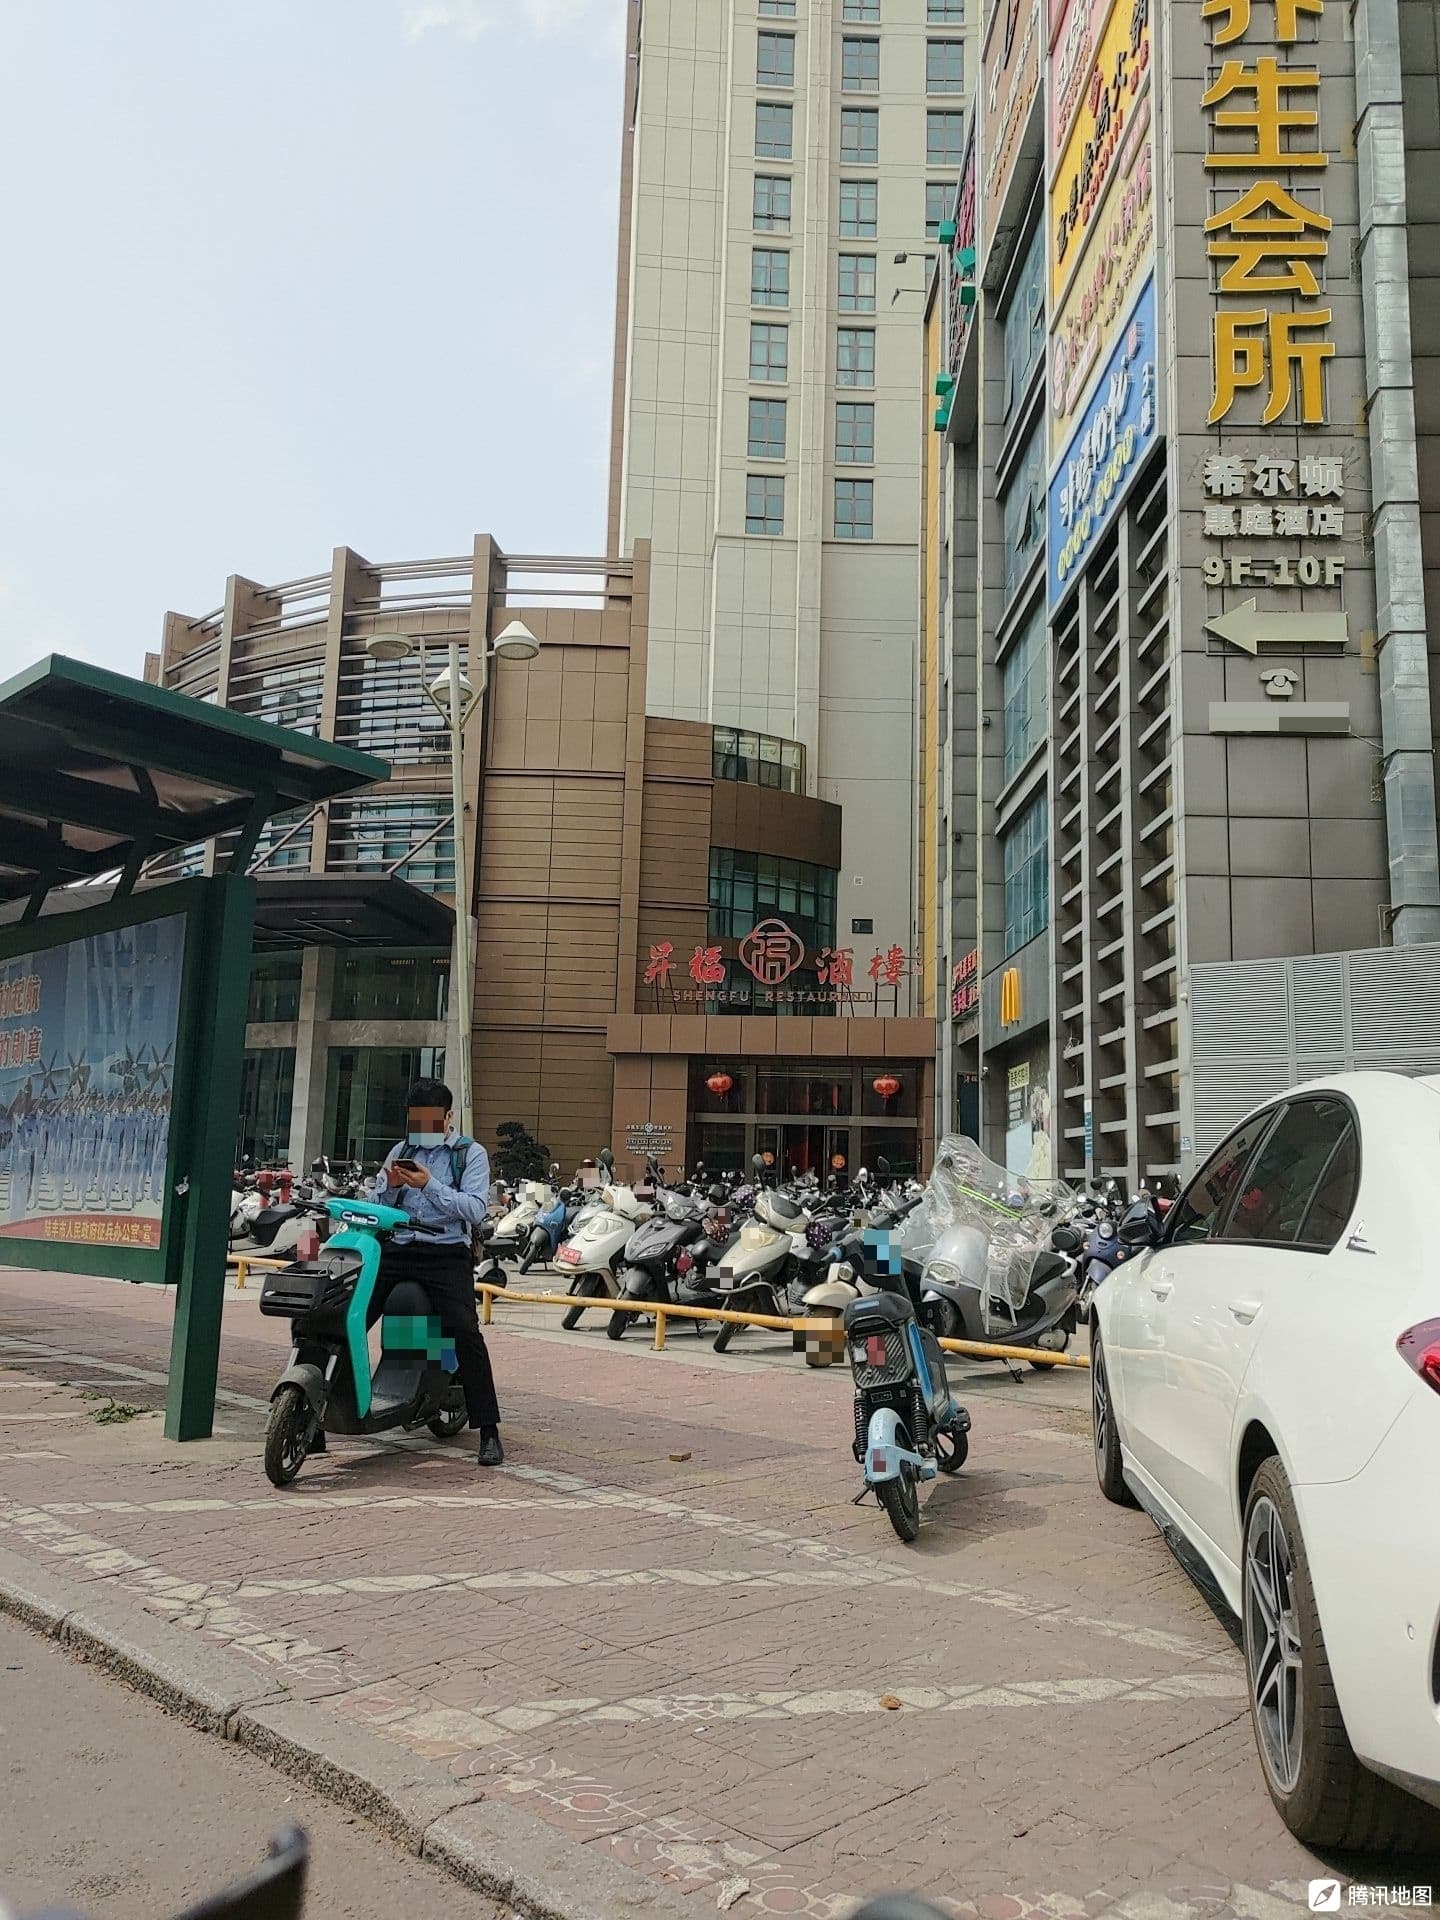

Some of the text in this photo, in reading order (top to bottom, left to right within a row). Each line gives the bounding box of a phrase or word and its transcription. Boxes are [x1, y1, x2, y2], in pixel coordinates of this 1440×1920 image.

[1204, 454, 1345, 497] 希尔顿
[1203, 504, 1345, 536] 惠庭酒店
[1202, 556, 1346, 585] 9F-10F
[673, 990, 749, 1002] SHENGFU
